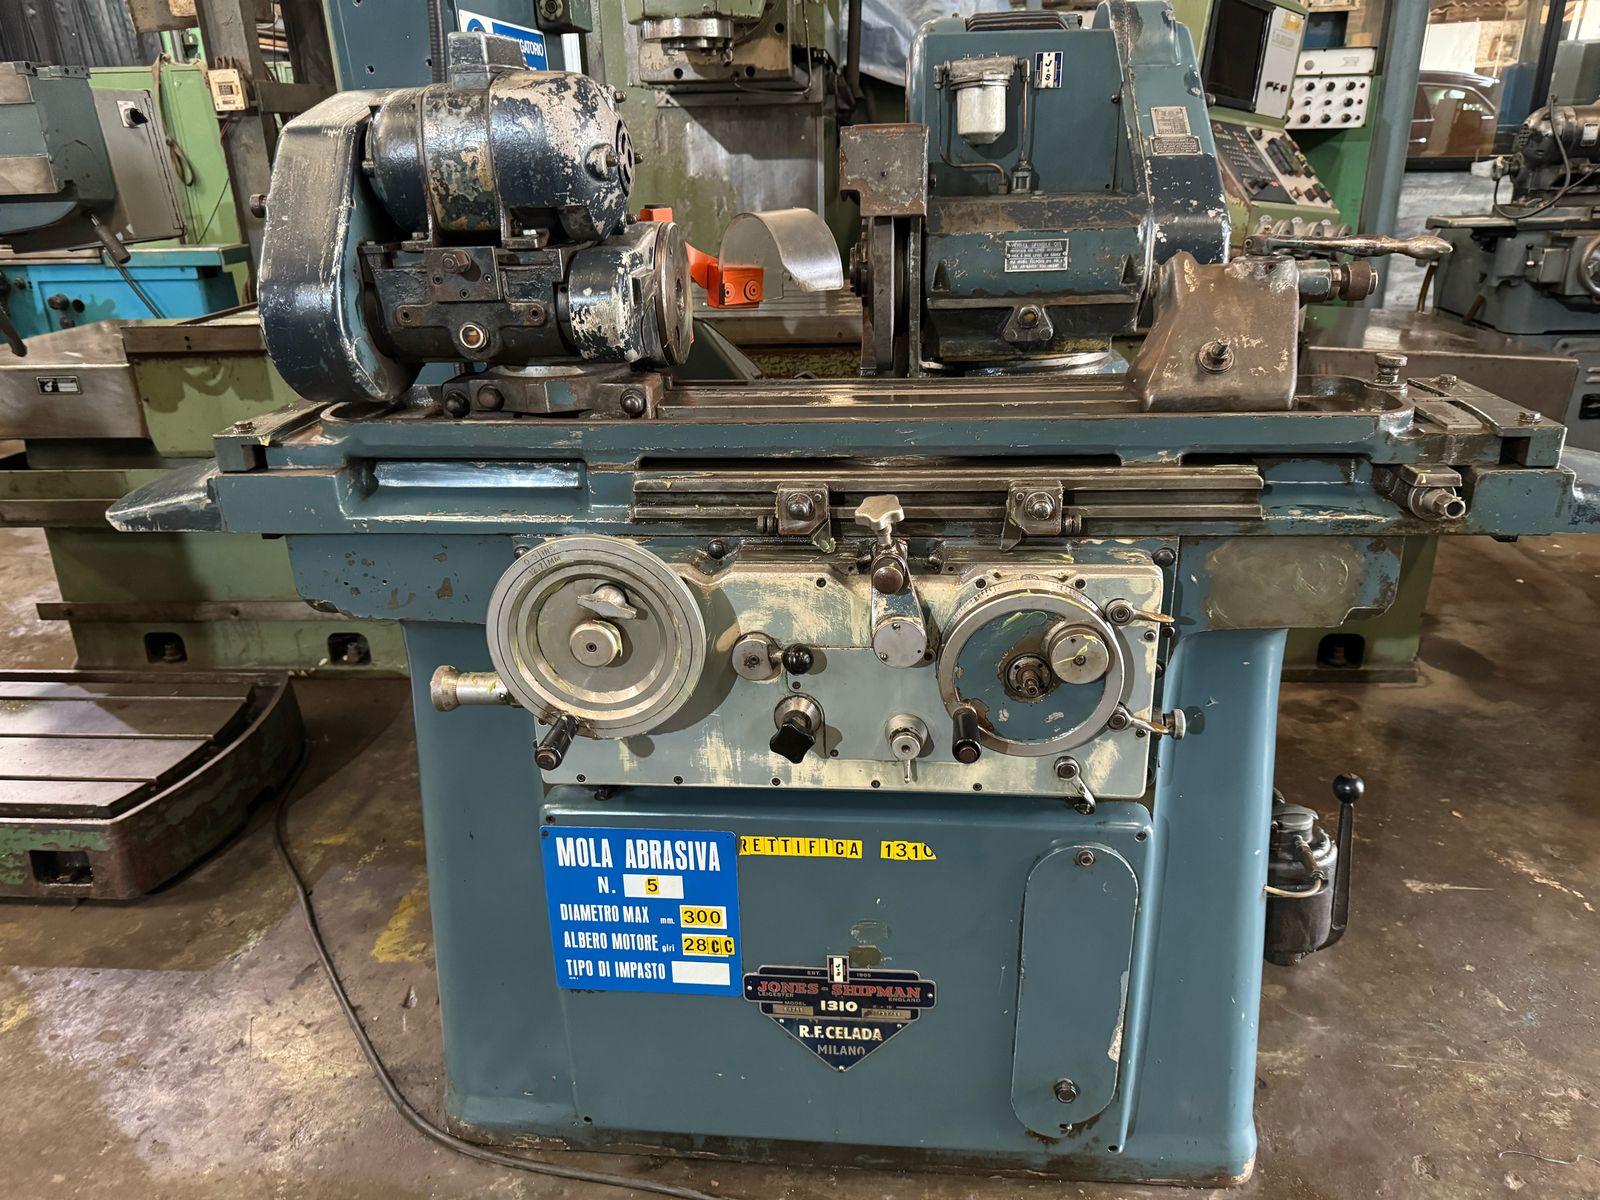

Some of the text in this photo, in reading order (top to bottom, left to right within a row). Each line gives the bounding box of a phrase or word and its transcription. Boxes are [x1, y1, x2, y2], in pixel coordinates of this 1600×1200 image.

[555, 837, 721, 871] MOLA ABRASIVA
[597, 876, 658, 893] N. 5
[560, 903, 721, 925] DIAMETRO MAX mm. 300
[564, 931, 608, 950] ALBERO
[611, 933, 659, 951] MOTORE
[566, 959, 666, 980] TIPO DI IMPASTO
[757, 981, 819, 995] JONES
[832, 983, 921, 999] SHIPMAN
[820, 1000, 858, 1012] 1310
[817, 1044, 866, 1056] MILANO
